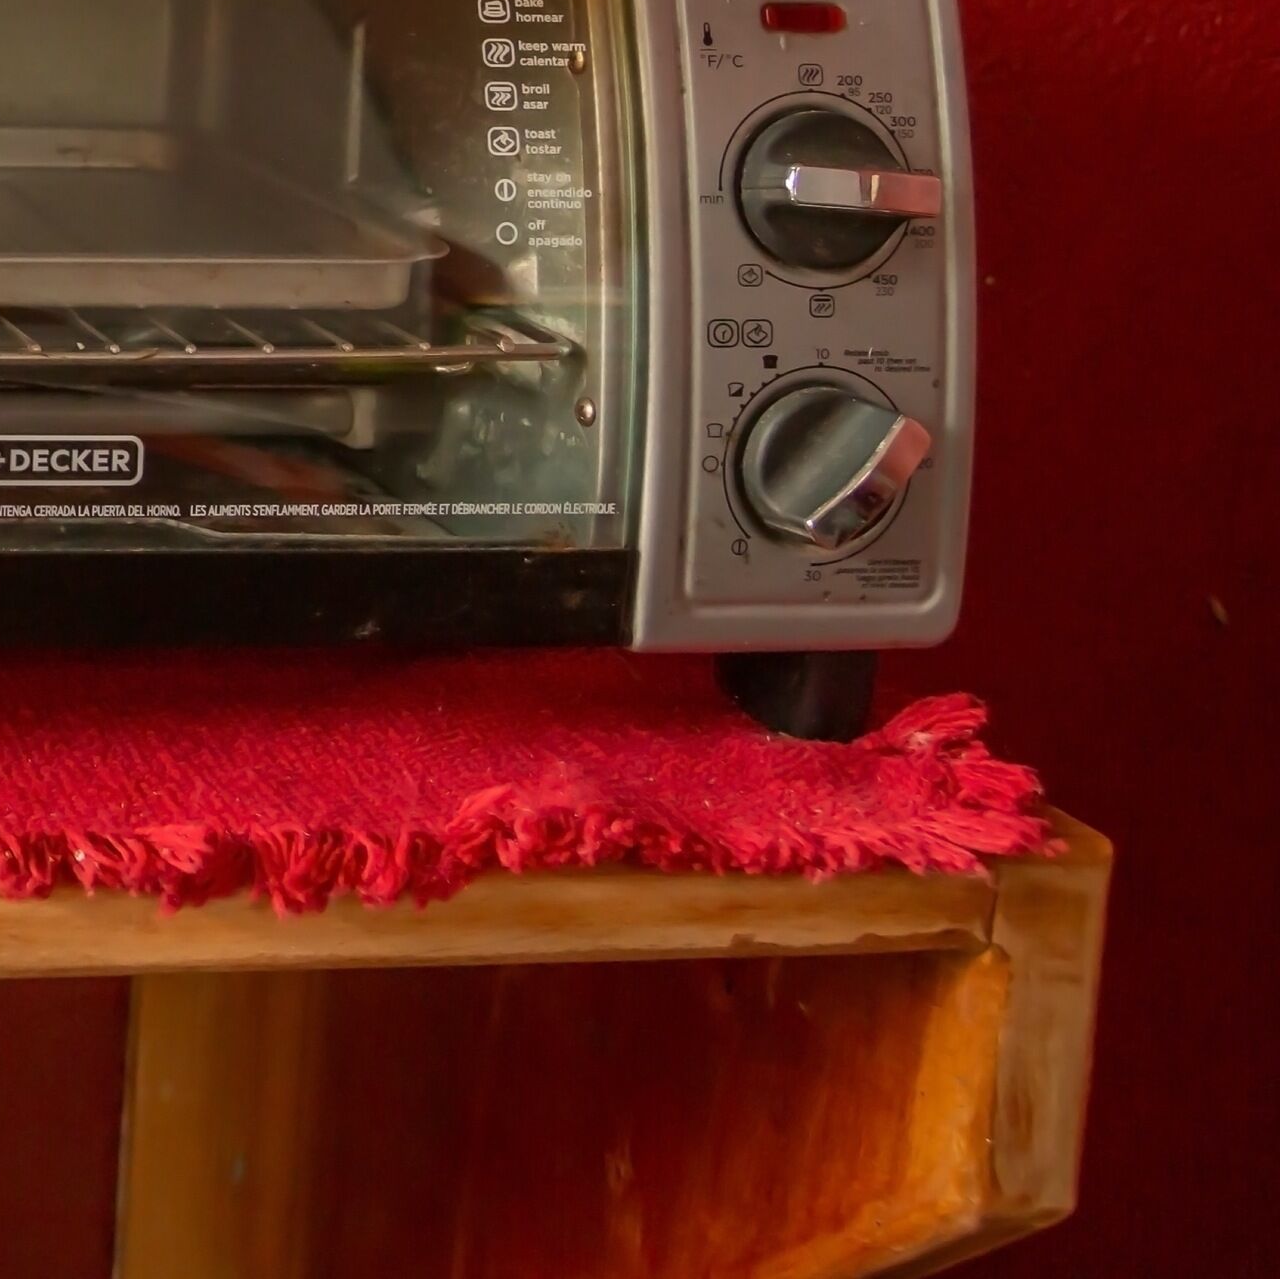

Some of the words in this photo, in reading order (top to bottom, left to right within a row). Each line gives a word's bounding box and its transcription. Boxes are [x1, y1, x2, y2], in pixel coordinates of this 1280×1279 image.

[515, 11, 564, 23] hornear
[518, 40, 549, 53] keep
[552, 42, 586, 52] warm
[520, 56, 570, 67] calentar
[836, 75, 863, 86] 200
[522, 84, 550, 95] broil
[848, 87, 861, 97] 95
[868, 92, 893, 103] 250
[523, 101, 549, 110] asar
[890, 116, 916, 127] 300
[525, 129, 556, 139] toast
[526, 145, 562, 155] tostar
[527, 173, 552, 185] stay
[556, 174, 571, 182] on
[527, 187, 593, 198] encendido
[528, 199, 582, 209] continuo
[700, 193, 724, 204] min
[528, 220, 546, 230] off
[910, 225, 935, 236] 400
[528, 236, 583, 247] apagado
[872, 274, 898, 285] 450
[816, 348, 830, 359] 10
[34, 505, 76, 517] CERRADA
[78, 505, 90, 517] LA
[92, 505, 126, 517] PUERTA
[128, 505, 145, 517] DEL
[147, 505, 181, 517] HORNO.
[190, 504, 206, 517] LES
[208, 504, 251, 517] ALIMENTS
[321, 504, 357, 517] GARDER
[359, 504, 371, 517] LA
[373, 504, 402, 517] PORTE
[403, 501, 438, 515] FERMÉE
[439, 503, 450, 515] ET
[451, 501, 510, 515] DÉBRANCHER
[512, 503, 523, 515] LE
[524, 503, 561, 515] CORDON
[803, 571, 822, 581] 30
